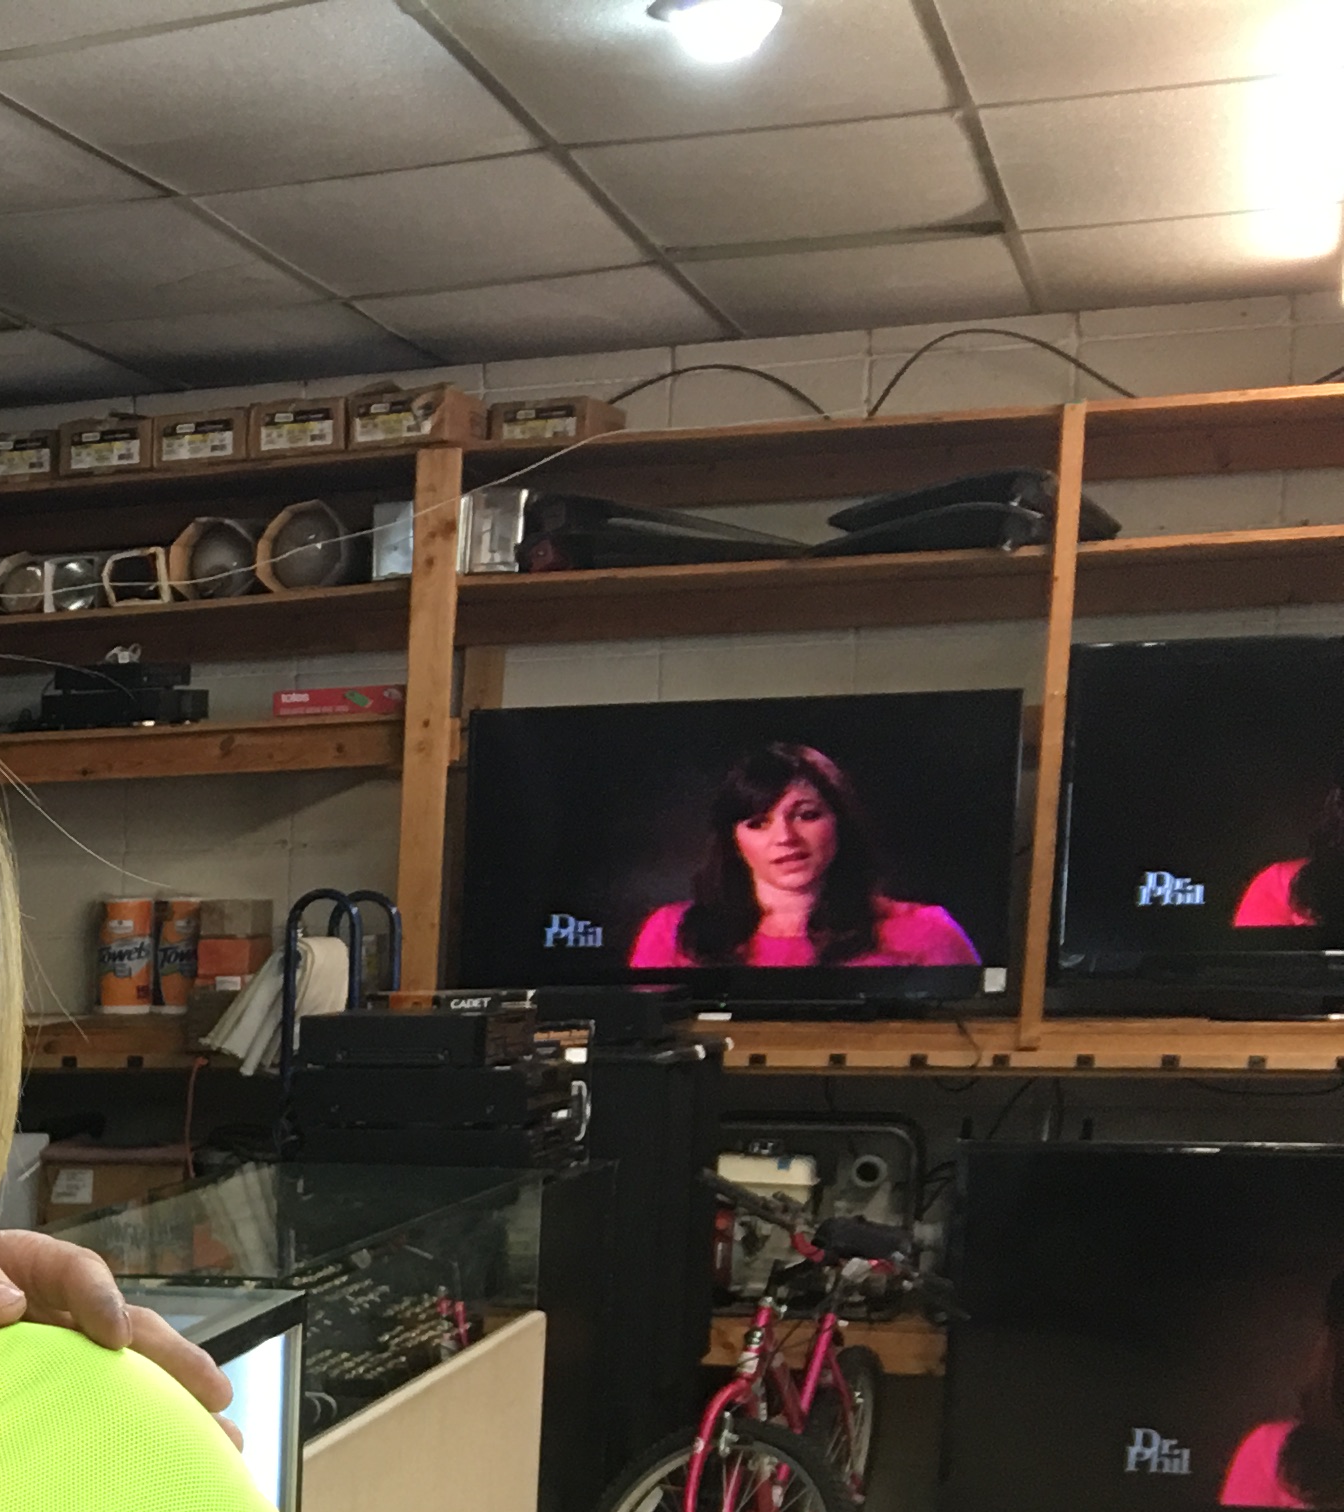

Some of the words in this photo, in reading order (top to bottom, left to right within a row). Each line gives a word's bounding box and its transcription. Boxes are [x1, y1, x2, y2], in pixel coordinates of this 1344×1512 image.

[1137, 884, 1206, 907] Phil
[450, 996, 492, 1010] CADET
[1124, 1447, 1192, 1475] Phil
